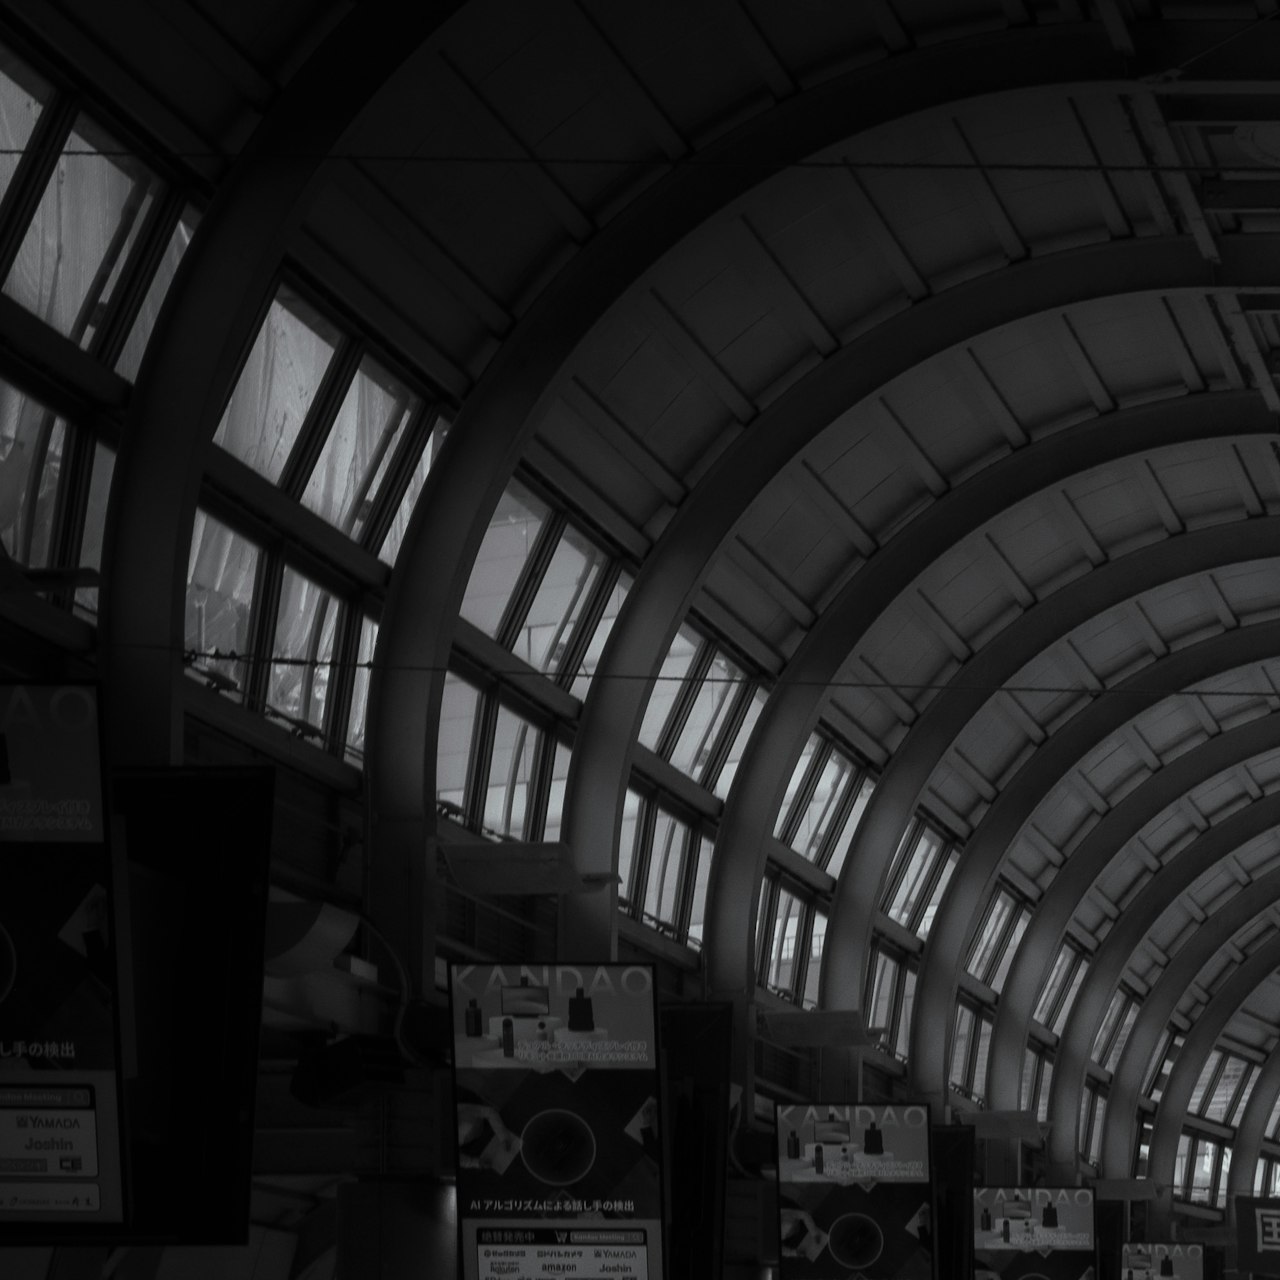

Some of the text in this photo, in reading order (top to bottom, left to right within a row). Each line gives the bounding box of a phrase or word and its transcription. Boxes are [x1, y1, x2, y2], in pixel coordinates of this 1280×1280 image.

[449, 965, 654, 996] KANDAO
[776, 1104, 928, 1128] KANDAO
[972, 1188, 1094, 1206] KANDAO
[469, 1200, 635, 1211] AI アルゴリズムによる話し手の検出
[602, 1249, 637, 1258] YAMADA
[598, 1264, 632, 1272] Joshin
